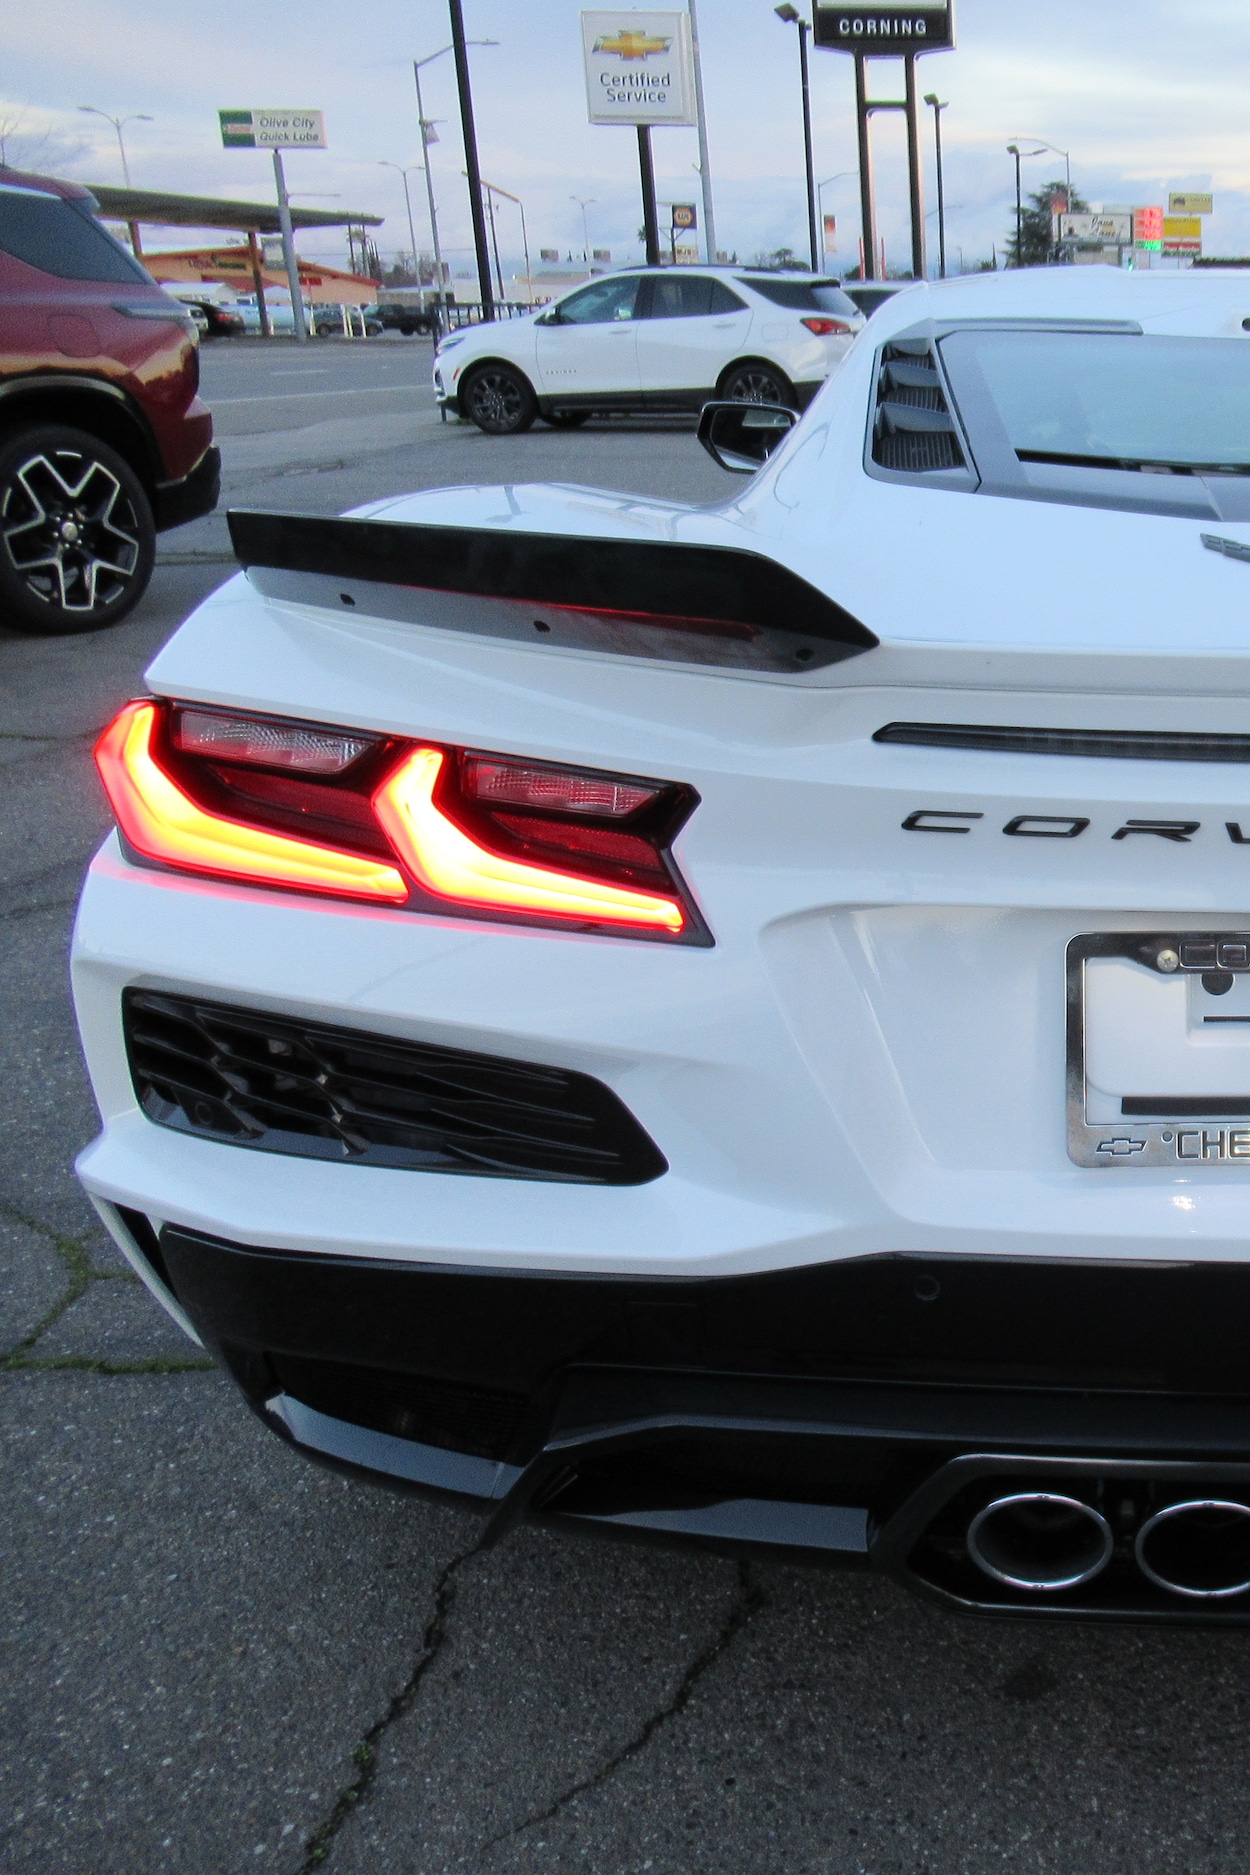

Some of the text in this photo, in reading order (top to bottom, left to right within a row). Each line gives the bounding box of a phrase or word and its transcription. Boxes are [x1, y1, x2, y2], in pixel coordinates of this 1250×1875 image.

[839, 18, 927, 35] CORNING
[600, 72, 671, 87] Certified
[606, 88, 667, 103] Service
[260, 117, 315, 129] Olive City
[260, 131, 320, 142] Quick Lube
